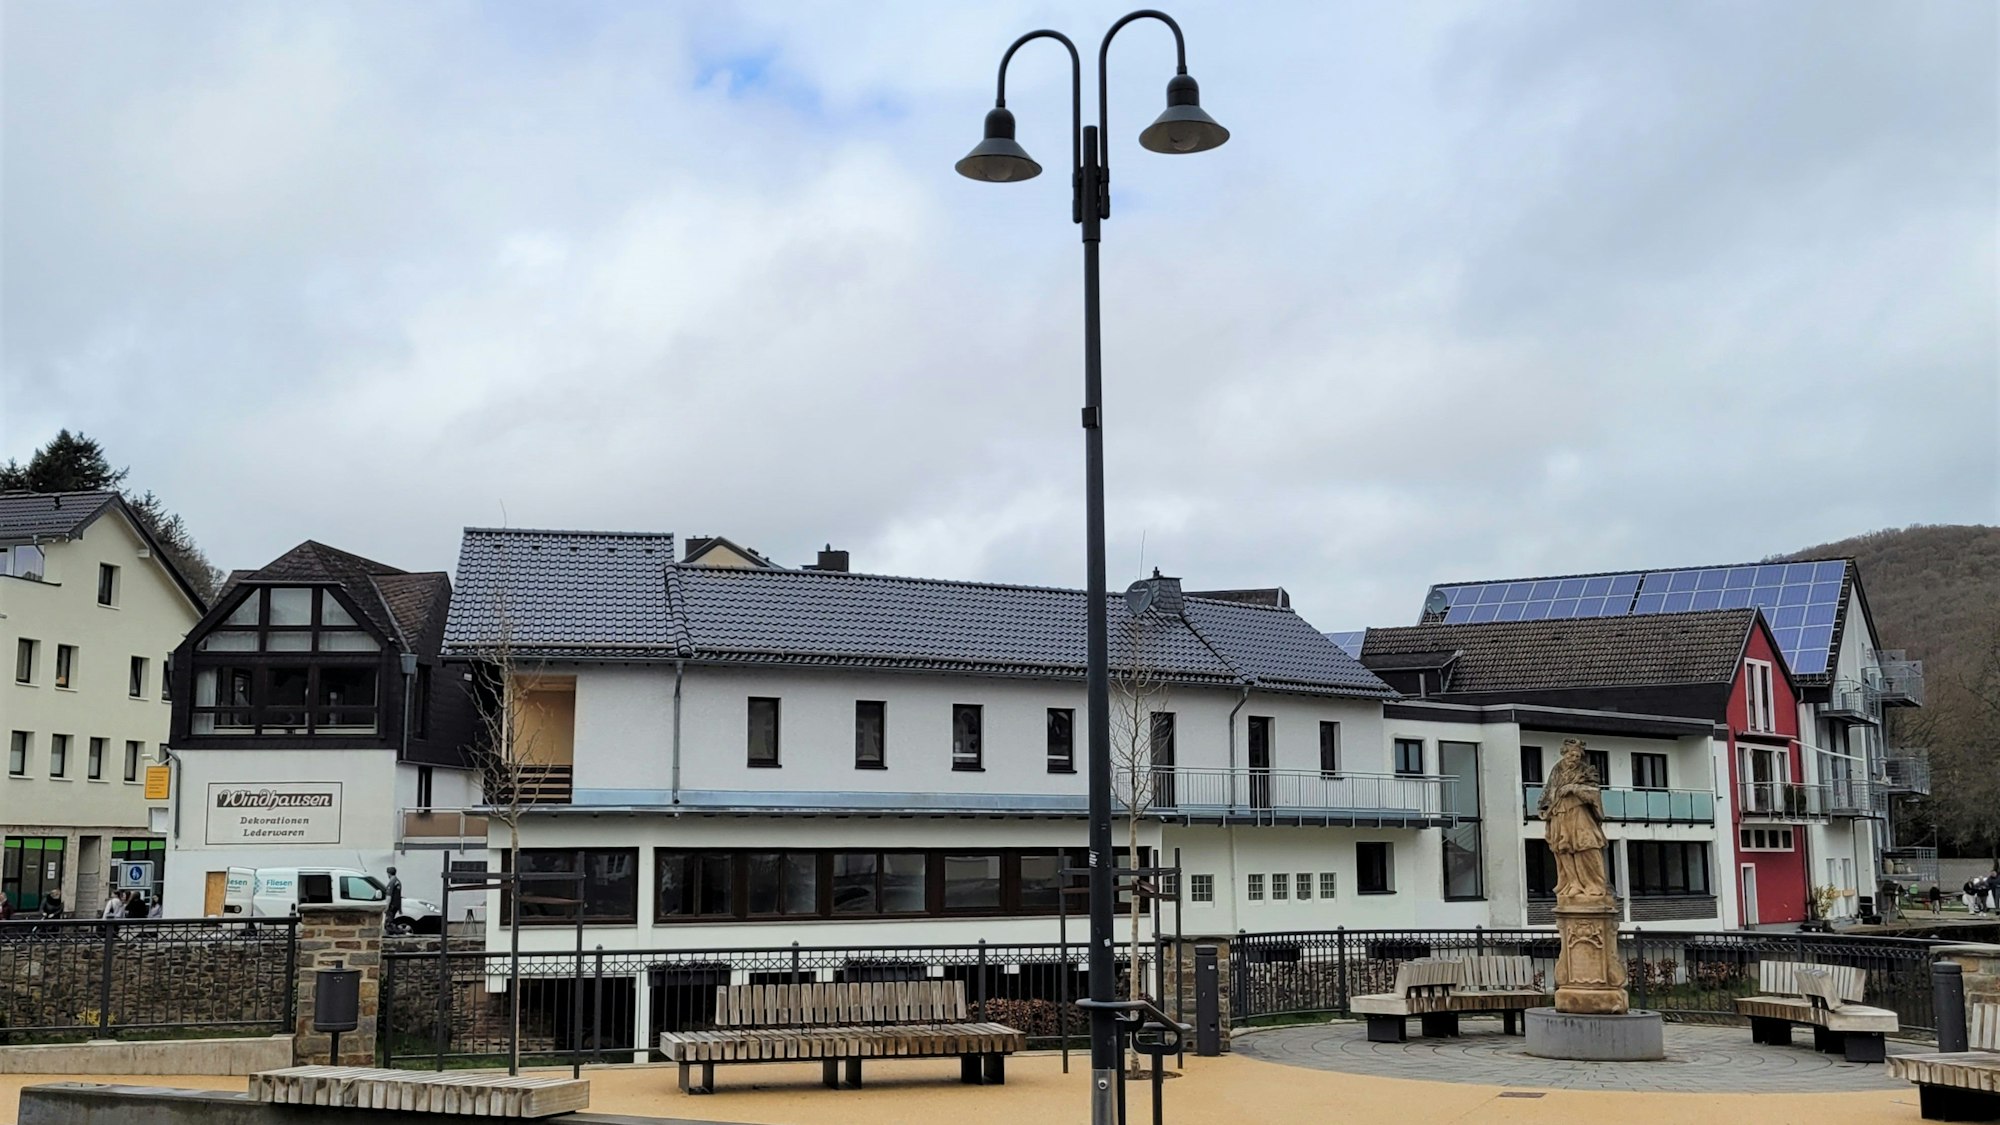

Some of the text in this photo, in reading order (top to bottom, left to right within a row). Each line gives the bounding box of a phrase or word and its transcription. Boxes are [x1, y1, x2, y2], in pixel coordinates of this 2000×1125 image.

[218, 789, 331, 811] Windhausen
[240, 816, 310, 825] Dekorationen
[243, 829, 305, 837] Lederwaren
[266, 879, 293, 887] Fliesen
